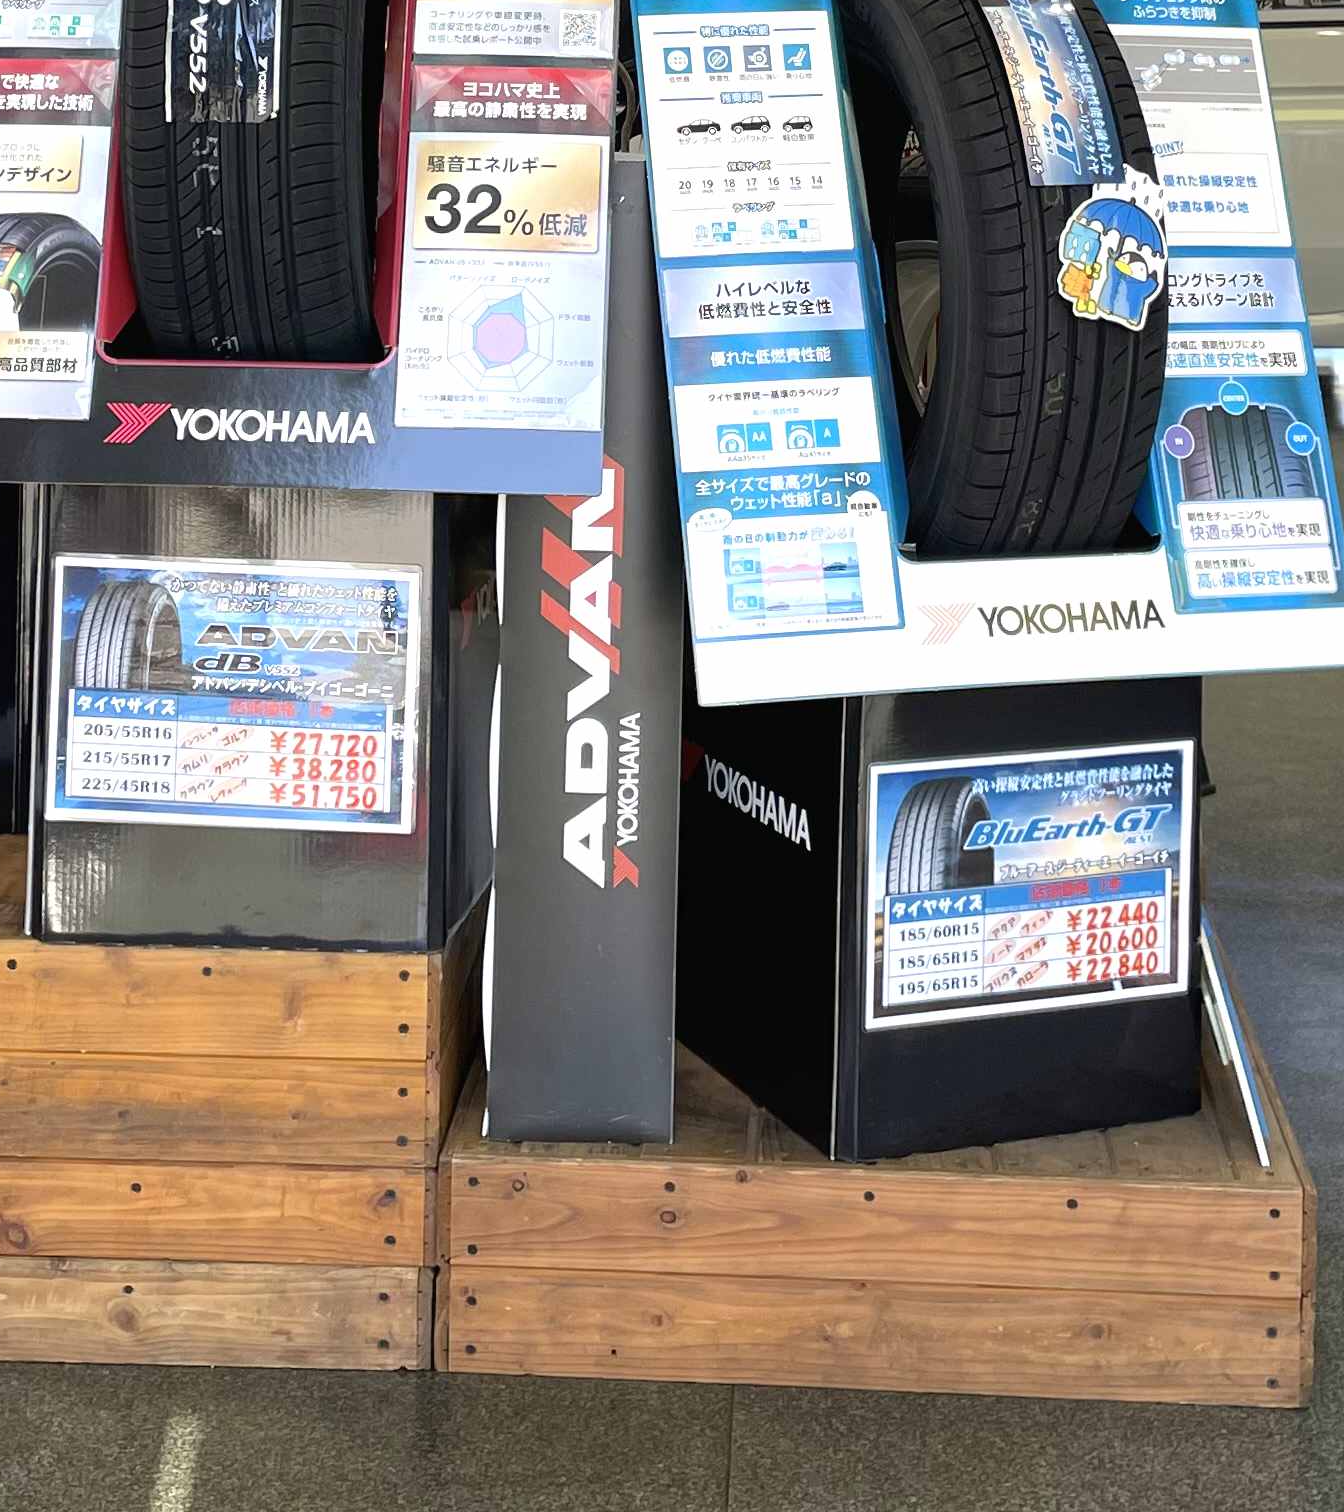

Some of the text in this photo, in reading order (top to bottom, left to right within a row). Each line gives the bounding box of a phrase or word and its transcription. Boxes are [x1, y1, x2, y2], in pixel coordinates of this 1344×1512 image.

[1132, 5, 1217, 22] ふらつきを抑制
[188, 14, 211, 96] V552
[463, 81, 561, 100] ヨコハマ史上
[433, 100, 588, 122] 最高の静粛性を実現
[426, 154, 558, 175] 騒音エネルギー
[1163, 174, 1258, 189] 優れた操縦安定性
[1167, 200, 1250, 214] 快適な乗り心地
[715, 278, 811, 298] ハイレベルな
[698, 298, 833, 321] 低燃費性と安全性
[710, 346, 833, 368] 優れた低燃費性能
[171, 407, 376, 446] YOKOHAMA
[695, 471, 872, 498] 全サイズで最高グレードの
[1186, 508, 1271, 522] 剛性をチューニングし
[1188, 521, 1322, 540] 快適な乗り心地を実現
[1195, 569, 1331, 589] 高い操縦安定性を実現
[976, 599, 1167, 638] YOKOHAMA
[194, 624, 400, 655] ADVAN
[192, 652, 262, 674] dB
[563, 468, 617, 889] ADVAN
[75, 696, 177, 716] タイヤサイズ
[83, 722, 173, 743] 205/55R16
[82, 748, 172, 769] 215/55R17
[81, 775, 171, 795] 225/45R18
[615, 711, 642, 847] YOKOHAMA
[703, 753, 812, 852] YOKOHAMA
[963, 803, 1174, 851] BluEarth-GT
[891, 893, 984, 918] タイヤサイズ
[898, 920, 981, 943] 185/60R15
[897, 948, 980, 970] 185/65R15
[897, 974, 980, 997] 195/65R15
